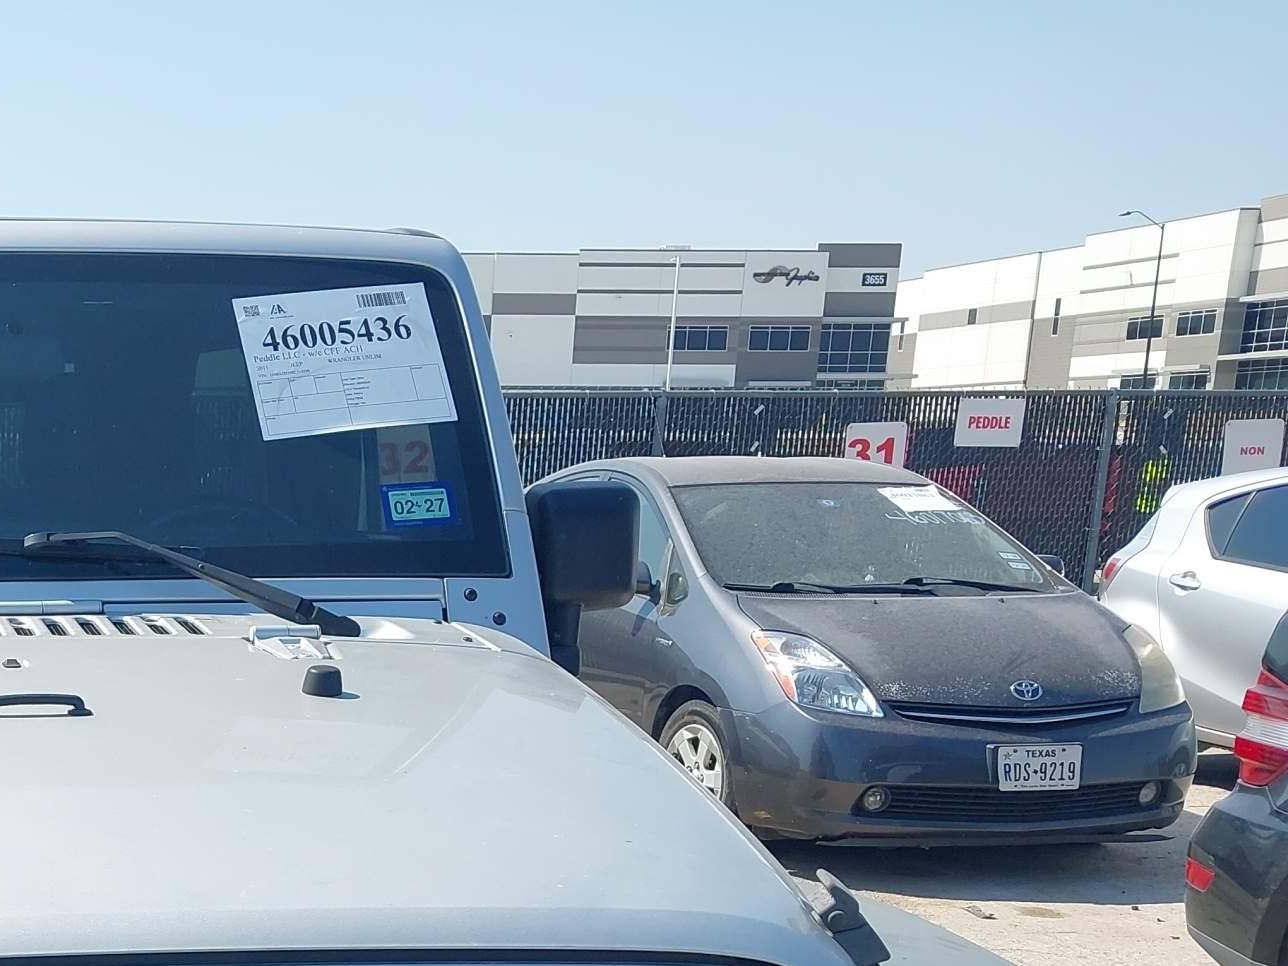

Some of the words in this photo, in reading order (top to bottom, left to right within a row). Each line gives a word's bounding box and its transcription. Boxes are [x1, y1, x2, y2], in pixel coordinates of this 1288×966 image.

[865, 275, 885, 285] 3655
[262, 314, 412, 352] 46005436
[253, 352, 281, 363] Peddle
[282, 350, 301, 360] LLC
[968, 416, 1011, 429] PEDDLE
[1240, 446, 1265, 456] NON
[394, 500, 417, 515] 02
[424, 498, 445, 513] 27
[1025, 749, 1057, 759] TEXAS
